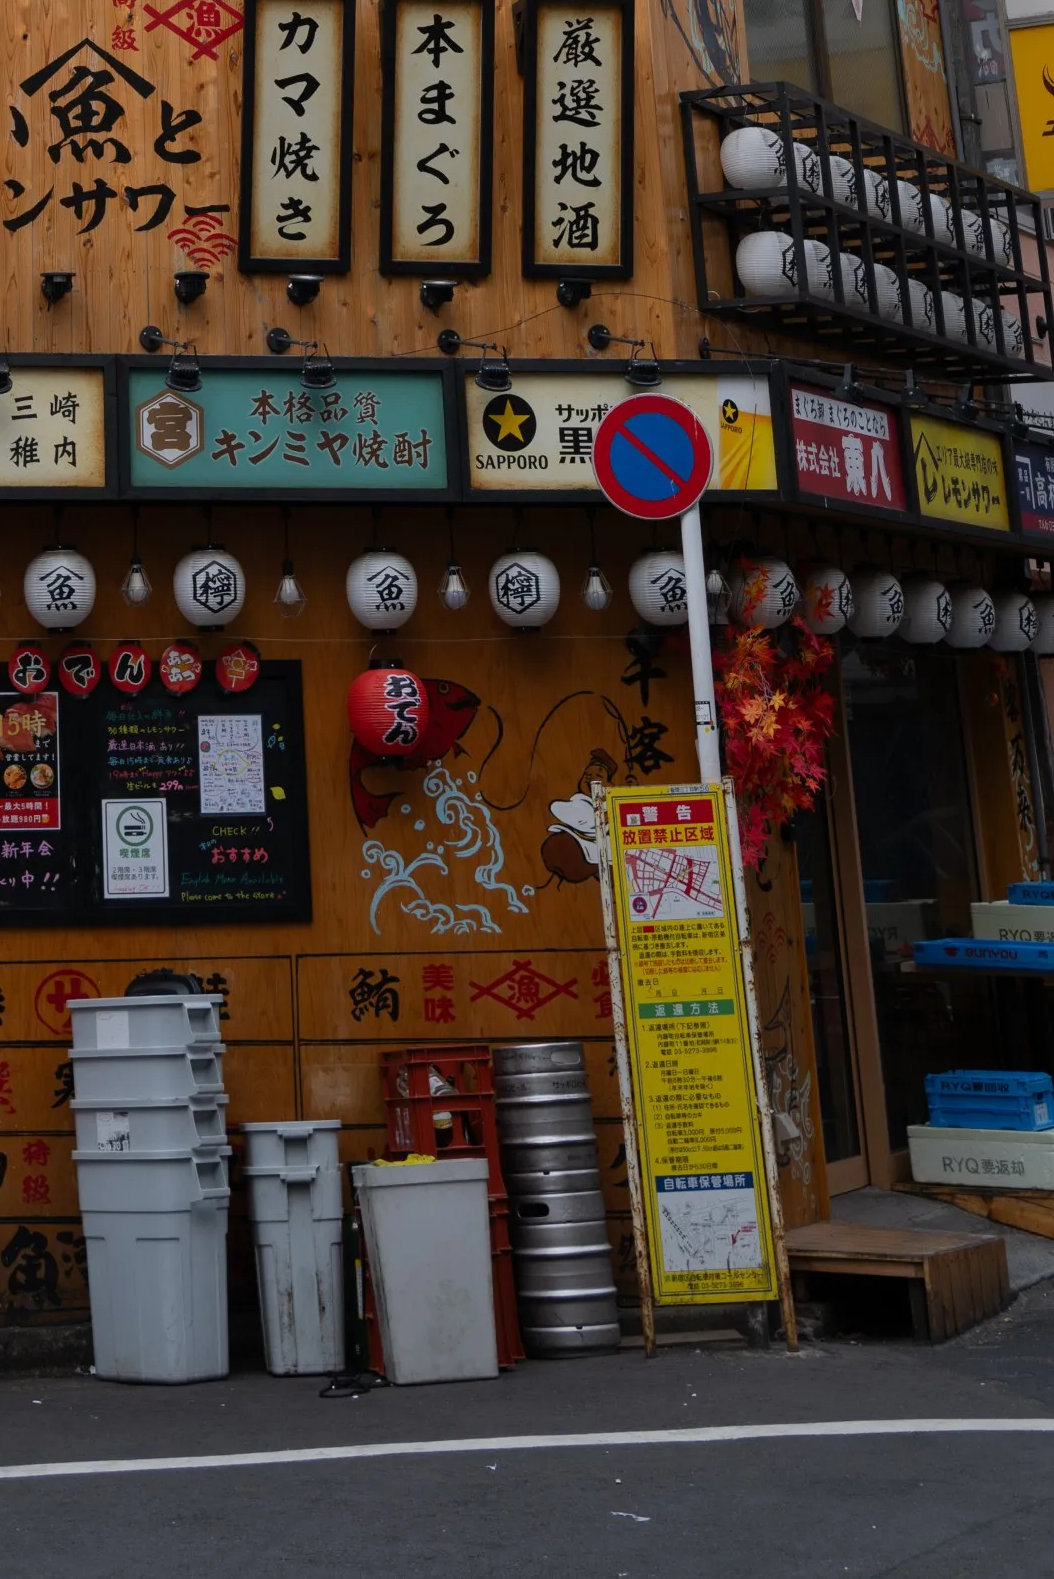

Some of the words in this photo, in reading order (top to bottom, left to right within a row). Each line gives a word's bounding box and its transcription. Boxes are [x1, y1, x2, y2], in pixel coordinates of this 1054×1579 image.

[185, 0, 226, 38] 漁
[270, 12, 321, 240] カマ焼き
[411, 13, 464, 246] 本まぐろ
[552, 18, 604, 251] 厳選地酒
[10, 390, 80, 423] 三崎
[248, 390, 381, 426] 本格品質
[9, 435, 78, 468] 稚内
[210, 428, 433, 471] キンミヤ焼酎
[475, 451, 550, 472] SAPPORO
[795, 439, 841, 478] 株式会社
[941, 474, 1001, 514] レモンサワー
[383, 674, 420, 746] おでん
[641, 804, 693, 823] 警告
[622, 826, 715, 846] 放置禁止区域
[120, 848, 151, 859] 喫煙席
[210, 846, 270, 865] おすすめ
[348, 967, 401, 1023] 鮪
[422, 965, 457, 1025] 美味
[507, 974, 544, 1003] 漁
[654, 1002, 719, 1017] 返還方法
[663, 1173, 746, 1191] 自転車保管場所
[942, 1156, 1025, 1177] RYQ要返却
